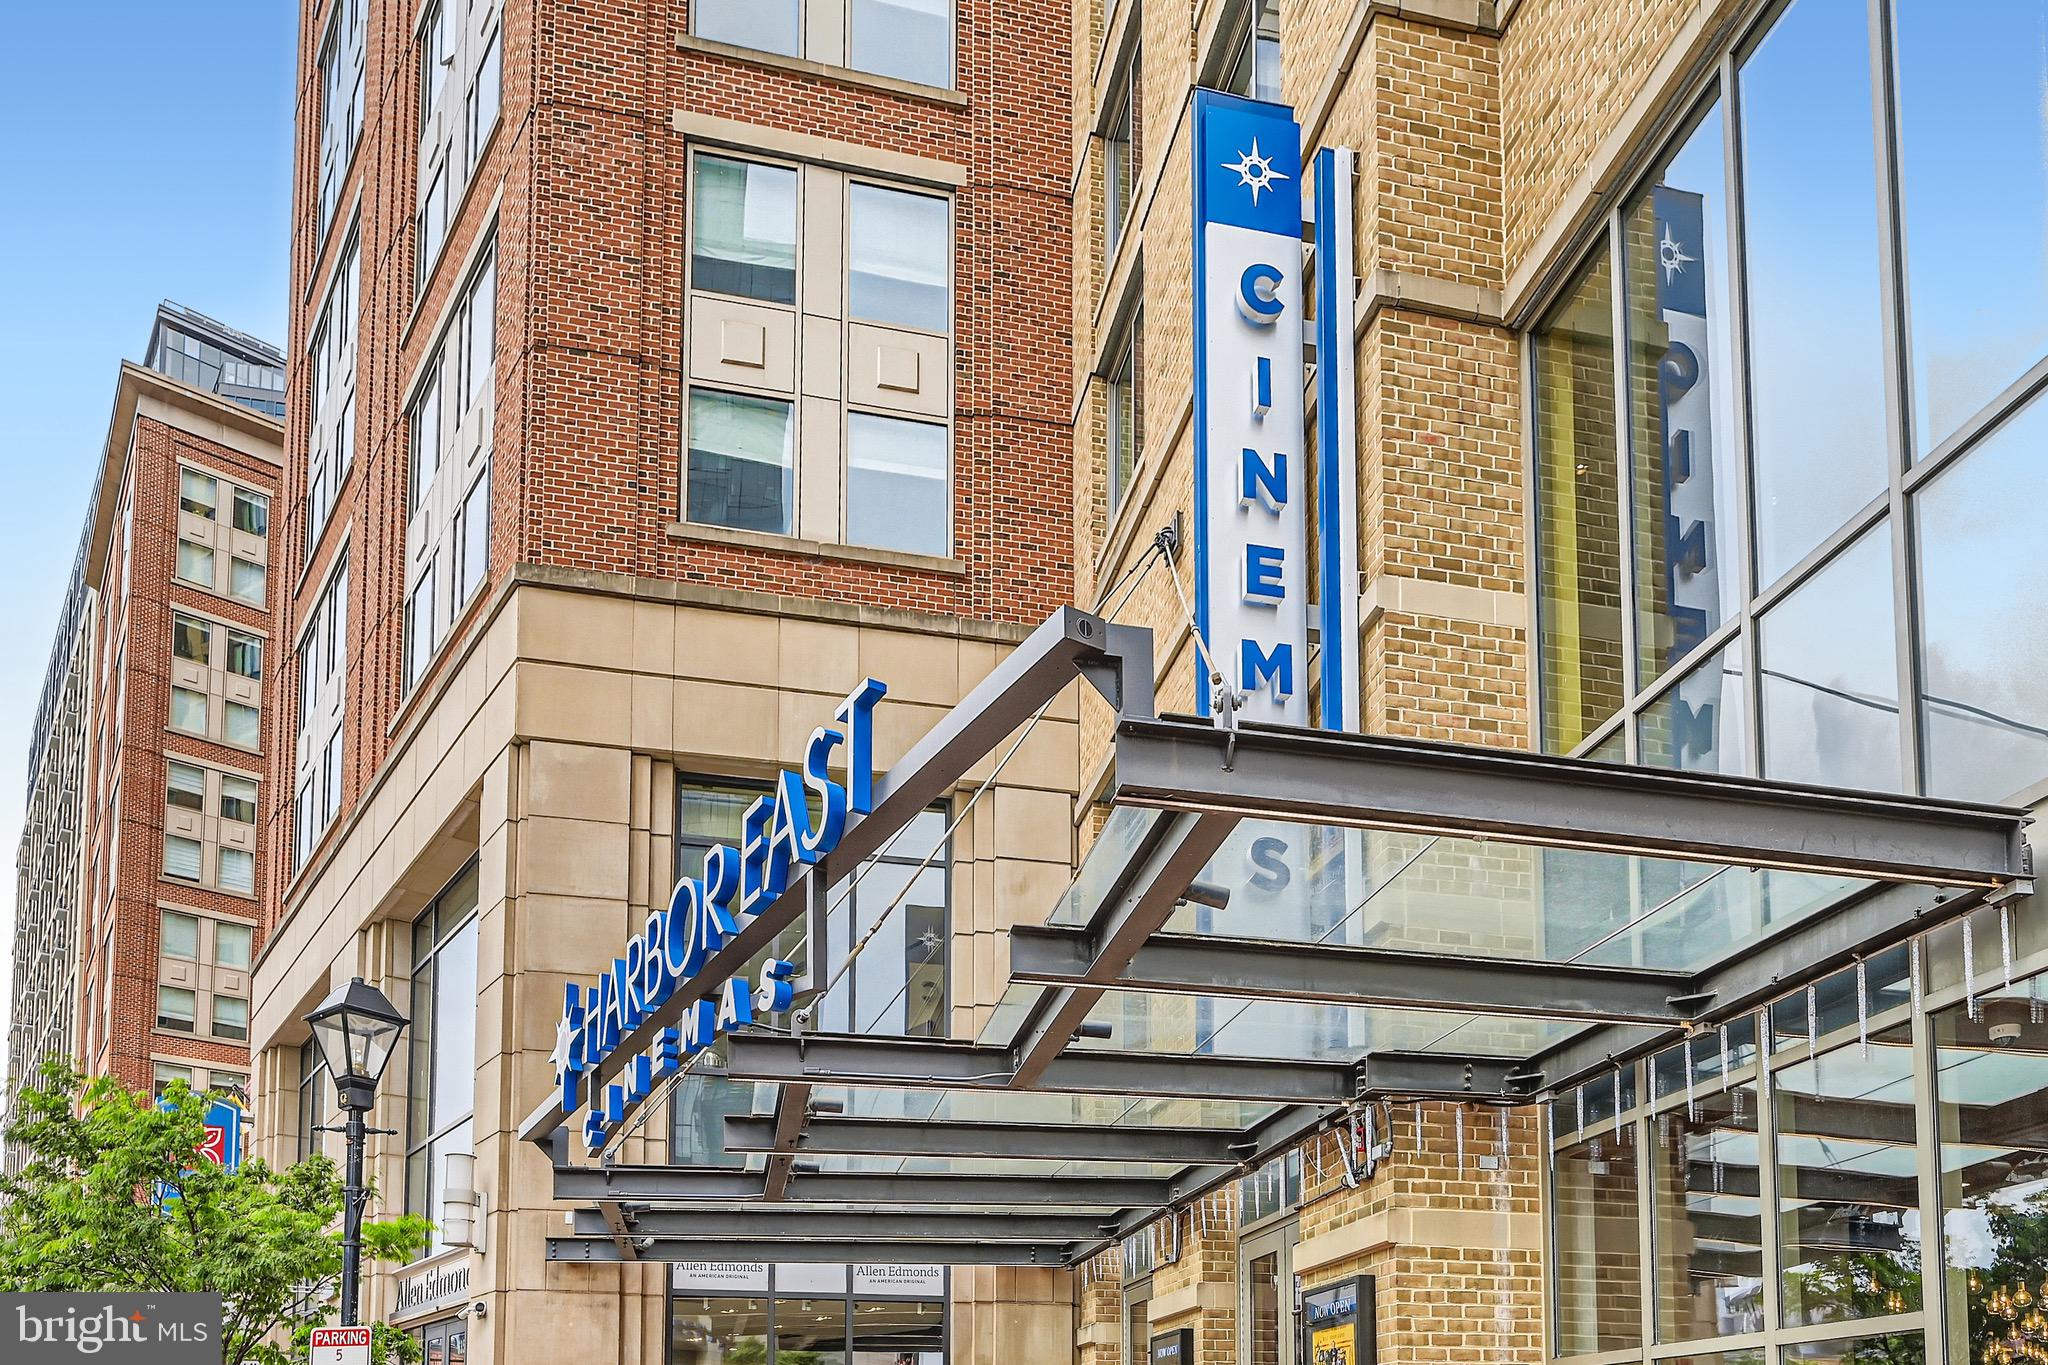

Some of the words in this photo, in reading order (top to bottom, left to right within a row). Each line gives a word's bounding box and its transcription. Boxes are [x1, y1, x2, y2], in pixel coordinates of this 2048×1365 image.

[583, 843, 740, 1065] HARBOR
[740, 677, 887, 916] EAST
[581, 958, 794, 1149] CINEMAS
[676, 1262, 707, 1271] Allen
[856, 1265, 886, 1277] Allen
[888, 1265, 940, 1277] Edmonds
[395, 1276, 424, 1312] Allen
[1313, 1303, 1330, 1320] NOW
[1330, 1298, 1351, 1316] OPEN
[315, 1330, 367, 1346] PARKING
[335, 1348, 343, 1362] 5
